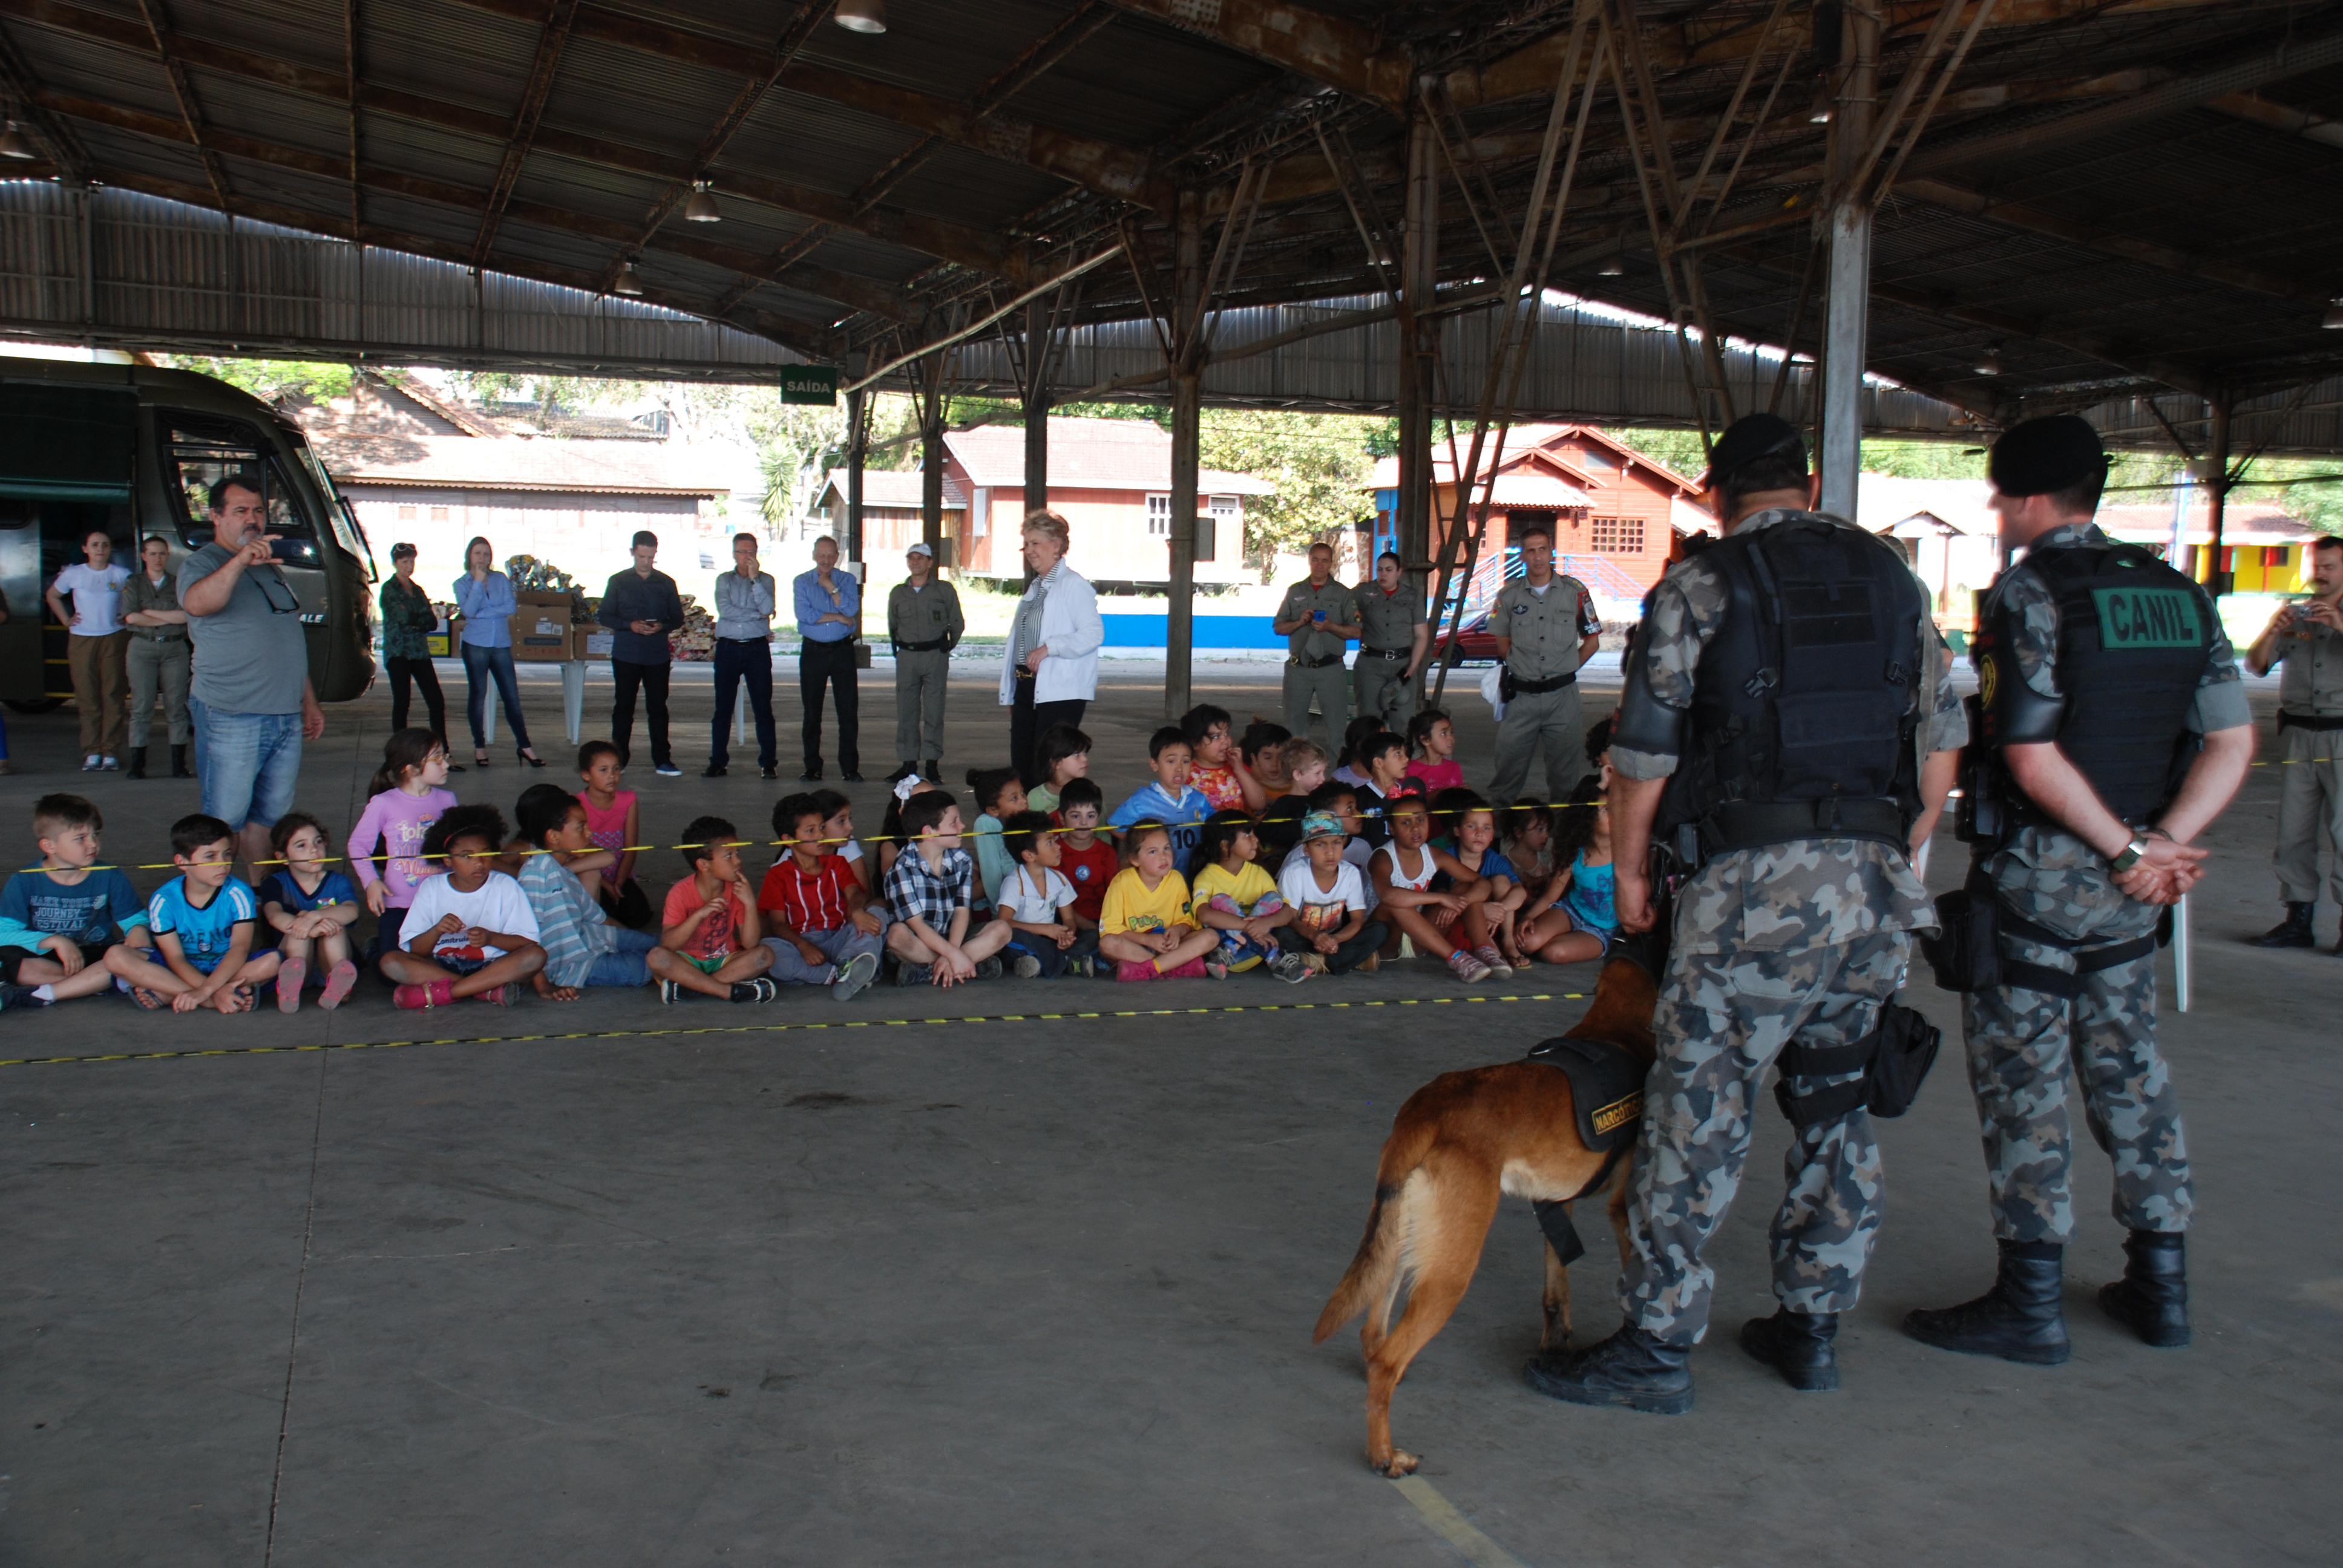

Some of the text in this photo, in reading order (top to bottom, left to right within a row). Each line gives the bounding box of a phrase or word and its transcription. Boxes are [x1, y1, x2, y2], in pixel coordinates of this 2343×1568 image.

[787, 379, 830, 393] SAÍDA
[299, 613, 324, 623] ALE
[2108, 594, 2194, 642] CANIL
[1173, 828, 1195, 849] 10
[30, 895, 91, 908] MAKE YOUR
[34, 907, 81, 918] JOURNEY
[1595, 1096, 1643, 1131] NARCÓTICO
